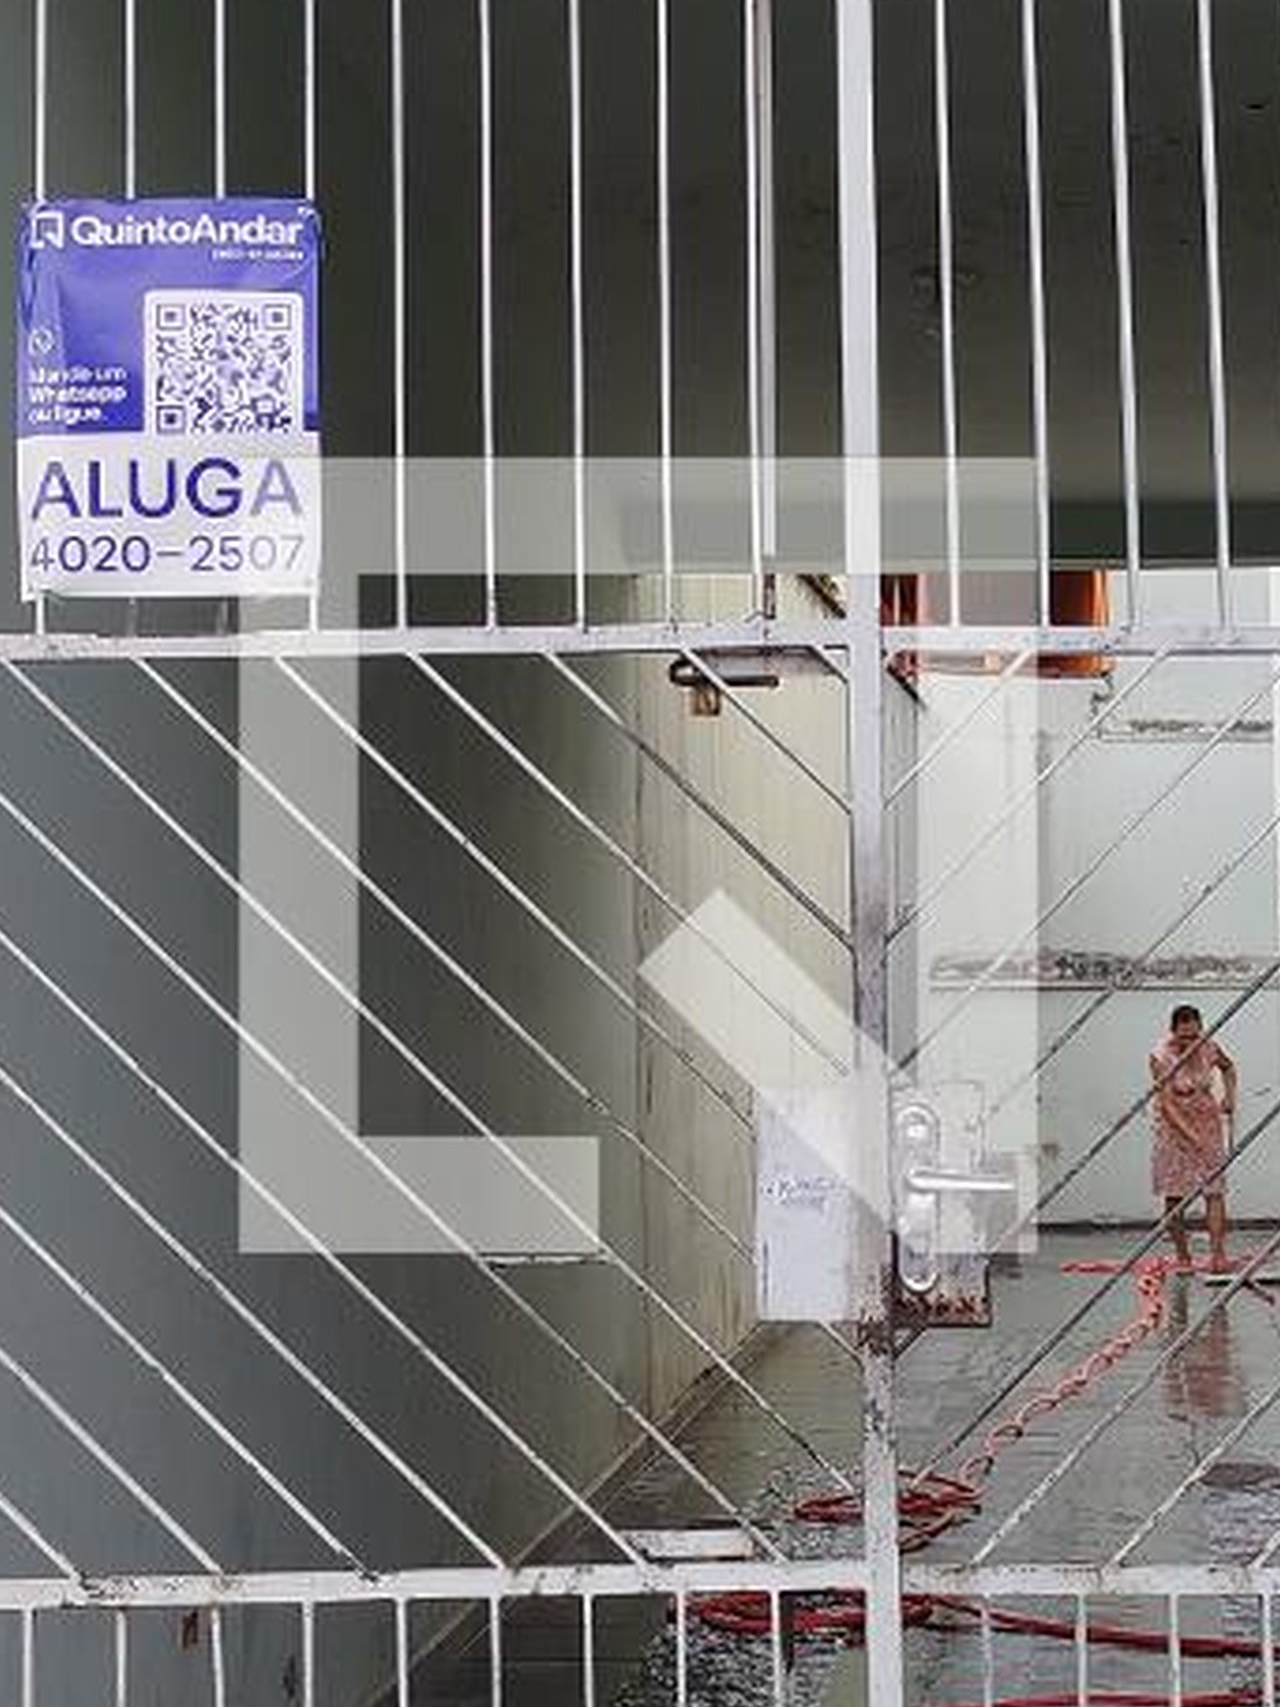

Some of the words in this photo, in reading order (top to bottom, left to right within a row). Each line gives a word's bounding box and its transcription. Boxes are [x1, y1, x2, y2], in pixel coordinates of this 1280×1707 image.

[71, 213, 304, 245] QuintoAndar
[31, 457, 302, 520] ALUGA
[30, 535, 304, 573] 4020-2507
